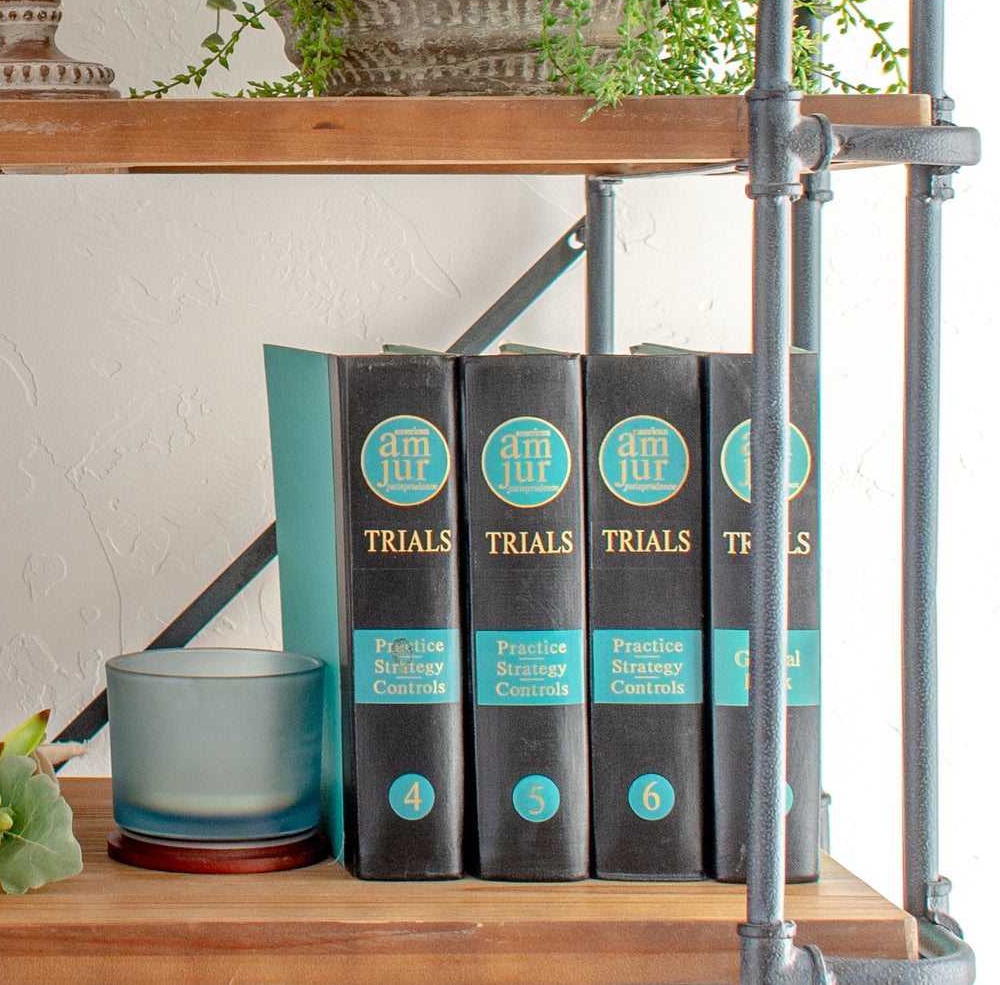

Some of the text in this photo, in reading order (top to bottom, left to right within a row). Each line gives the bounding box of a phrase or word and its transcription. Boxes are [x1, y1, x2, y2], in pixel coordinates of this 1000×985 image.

[379, 432, 431, 457] am
[500, 434, 552, 459] am
[617, 432, 669, 457] am
[377, 459, 430, 487] jur
[498, 460, 551, 489] jur
[615, 459, 669, 487] jur
[364, 529, 452, 552] TRIALS
[485, 530, 574, 554] TRIALS
[602, 529, 692, 552] TRIALS
[723, 531, 811, 554] TRLS
[375, 638, 445, 653] Practice
[497, 640, 568, 655] Practice
[612, 638, 684, 653] Practice
[374, 659, 445, 676] Strategy
[496, 661, 567, 678] Strategy
[611, 659, 683, 676] Strategy
[373, 680, 446, 695] Controls
[495, 682, 569, 697] Controls
[610, 680, 685, 695] Controls
[403, 781, 422, 811] 4
[528, 784, 545, 815] 5
[642, 781, 661, 811] 6
